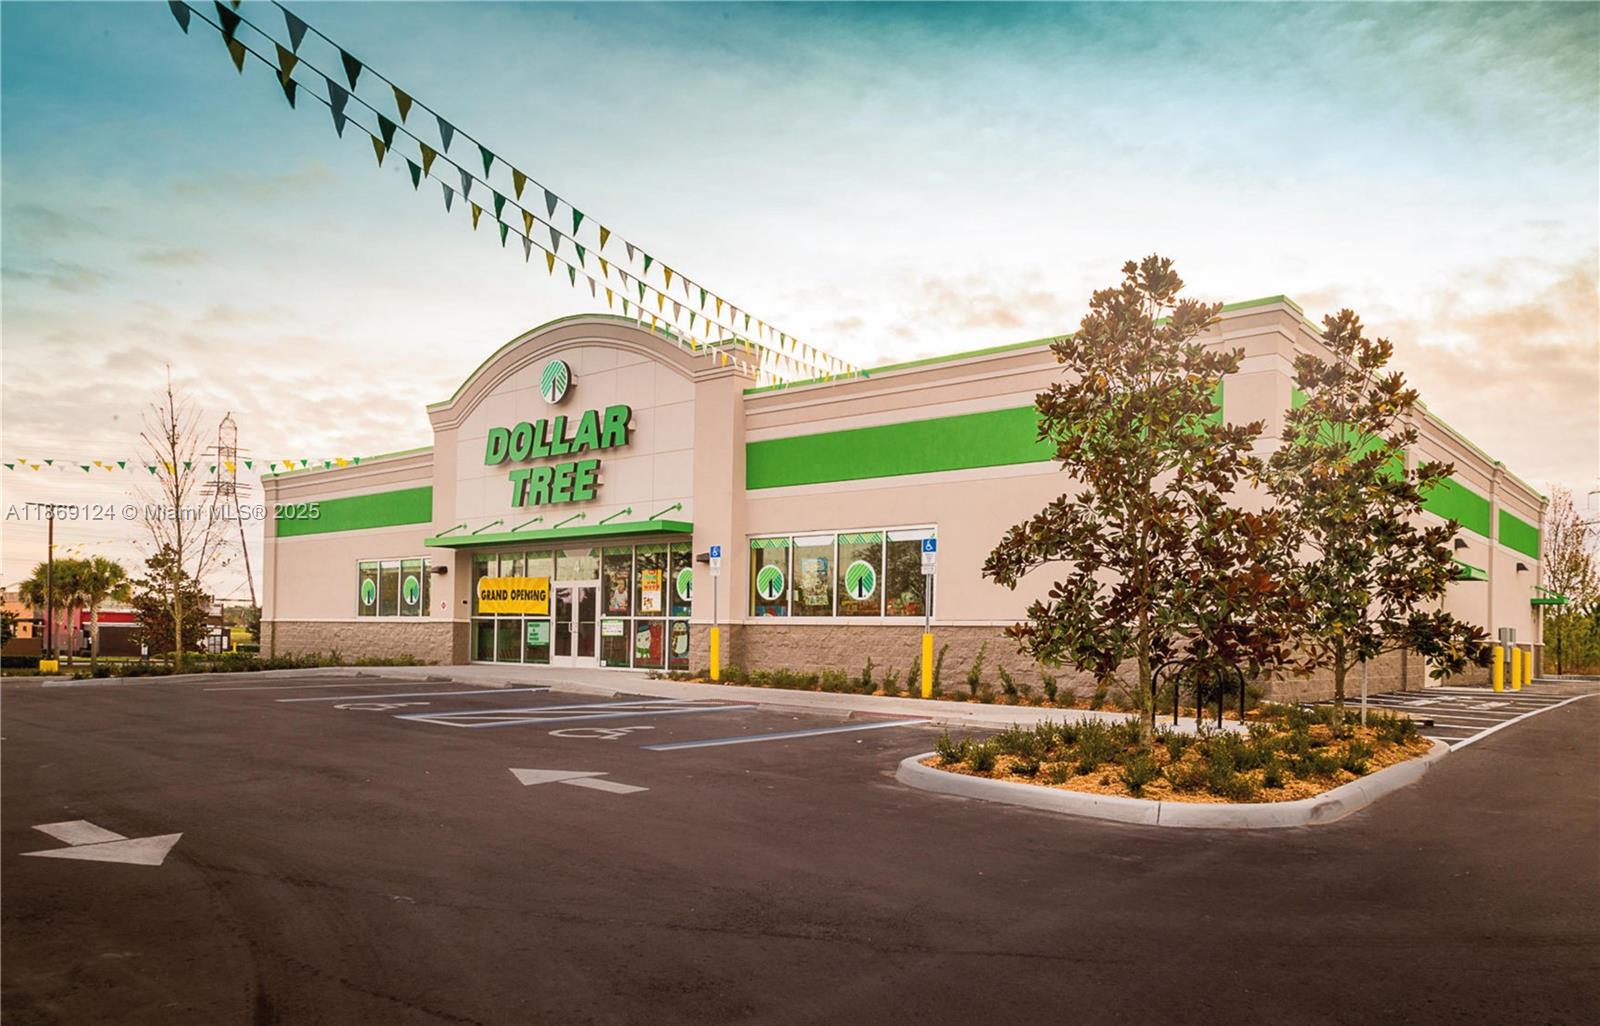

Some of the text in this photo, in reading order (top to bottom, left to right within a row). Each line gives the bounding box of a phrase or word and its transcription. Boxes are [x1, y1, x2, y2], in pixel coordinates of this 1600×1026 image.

[484, 404, 632, 466] DOLLAR
[508, 459, 601, 507] TREE
[481, 590, 546, 601] GRAND OPENING
